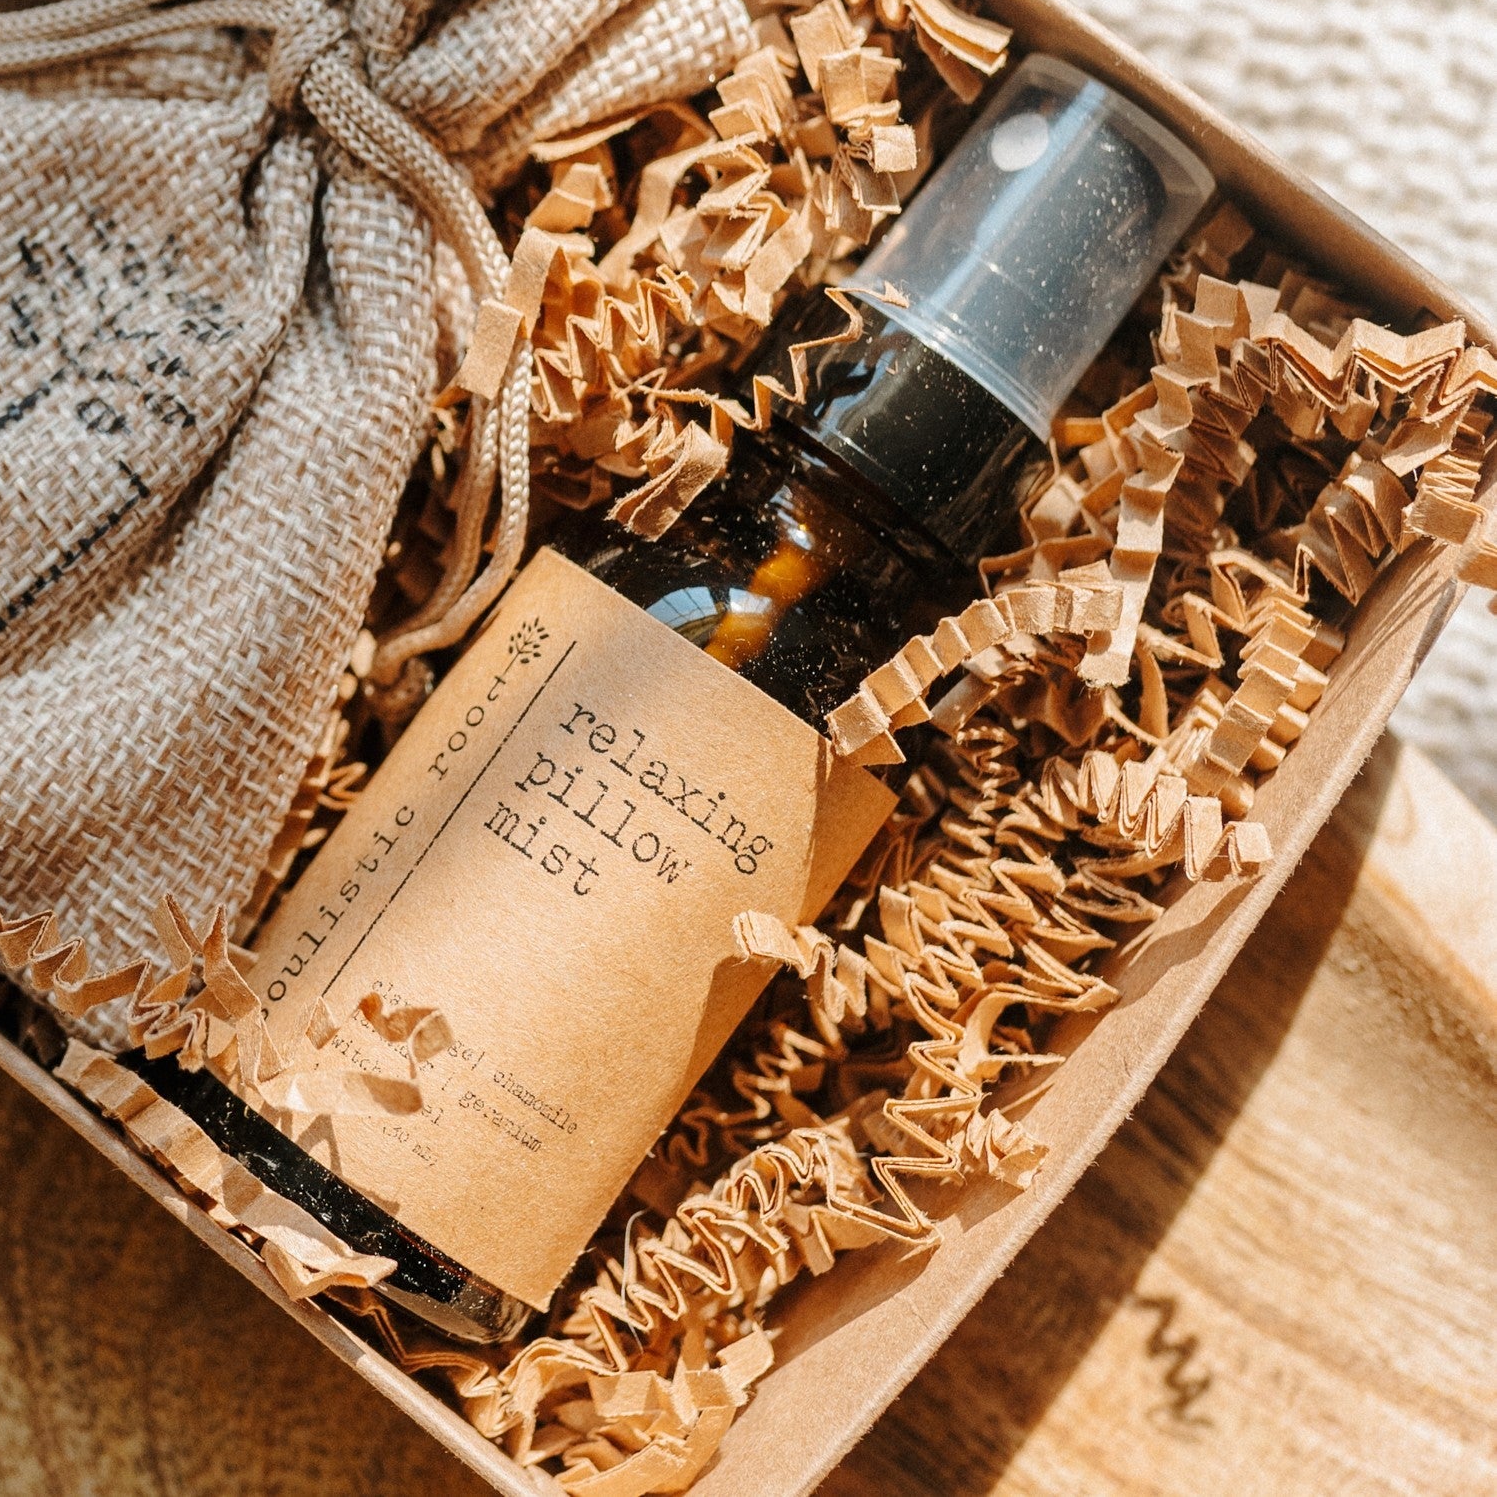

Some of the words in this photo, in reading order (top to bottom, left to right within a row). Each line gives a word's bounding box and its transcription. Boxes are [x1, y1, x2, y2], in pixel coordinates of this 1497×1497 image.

[427, 668, 508, 782] root
[514, 751, 692, 885] pillow
[558, 702, 774, 875] relaxing
[483, 801, 600, 897] mist
[457, 1089, 543, 1153] geranium
